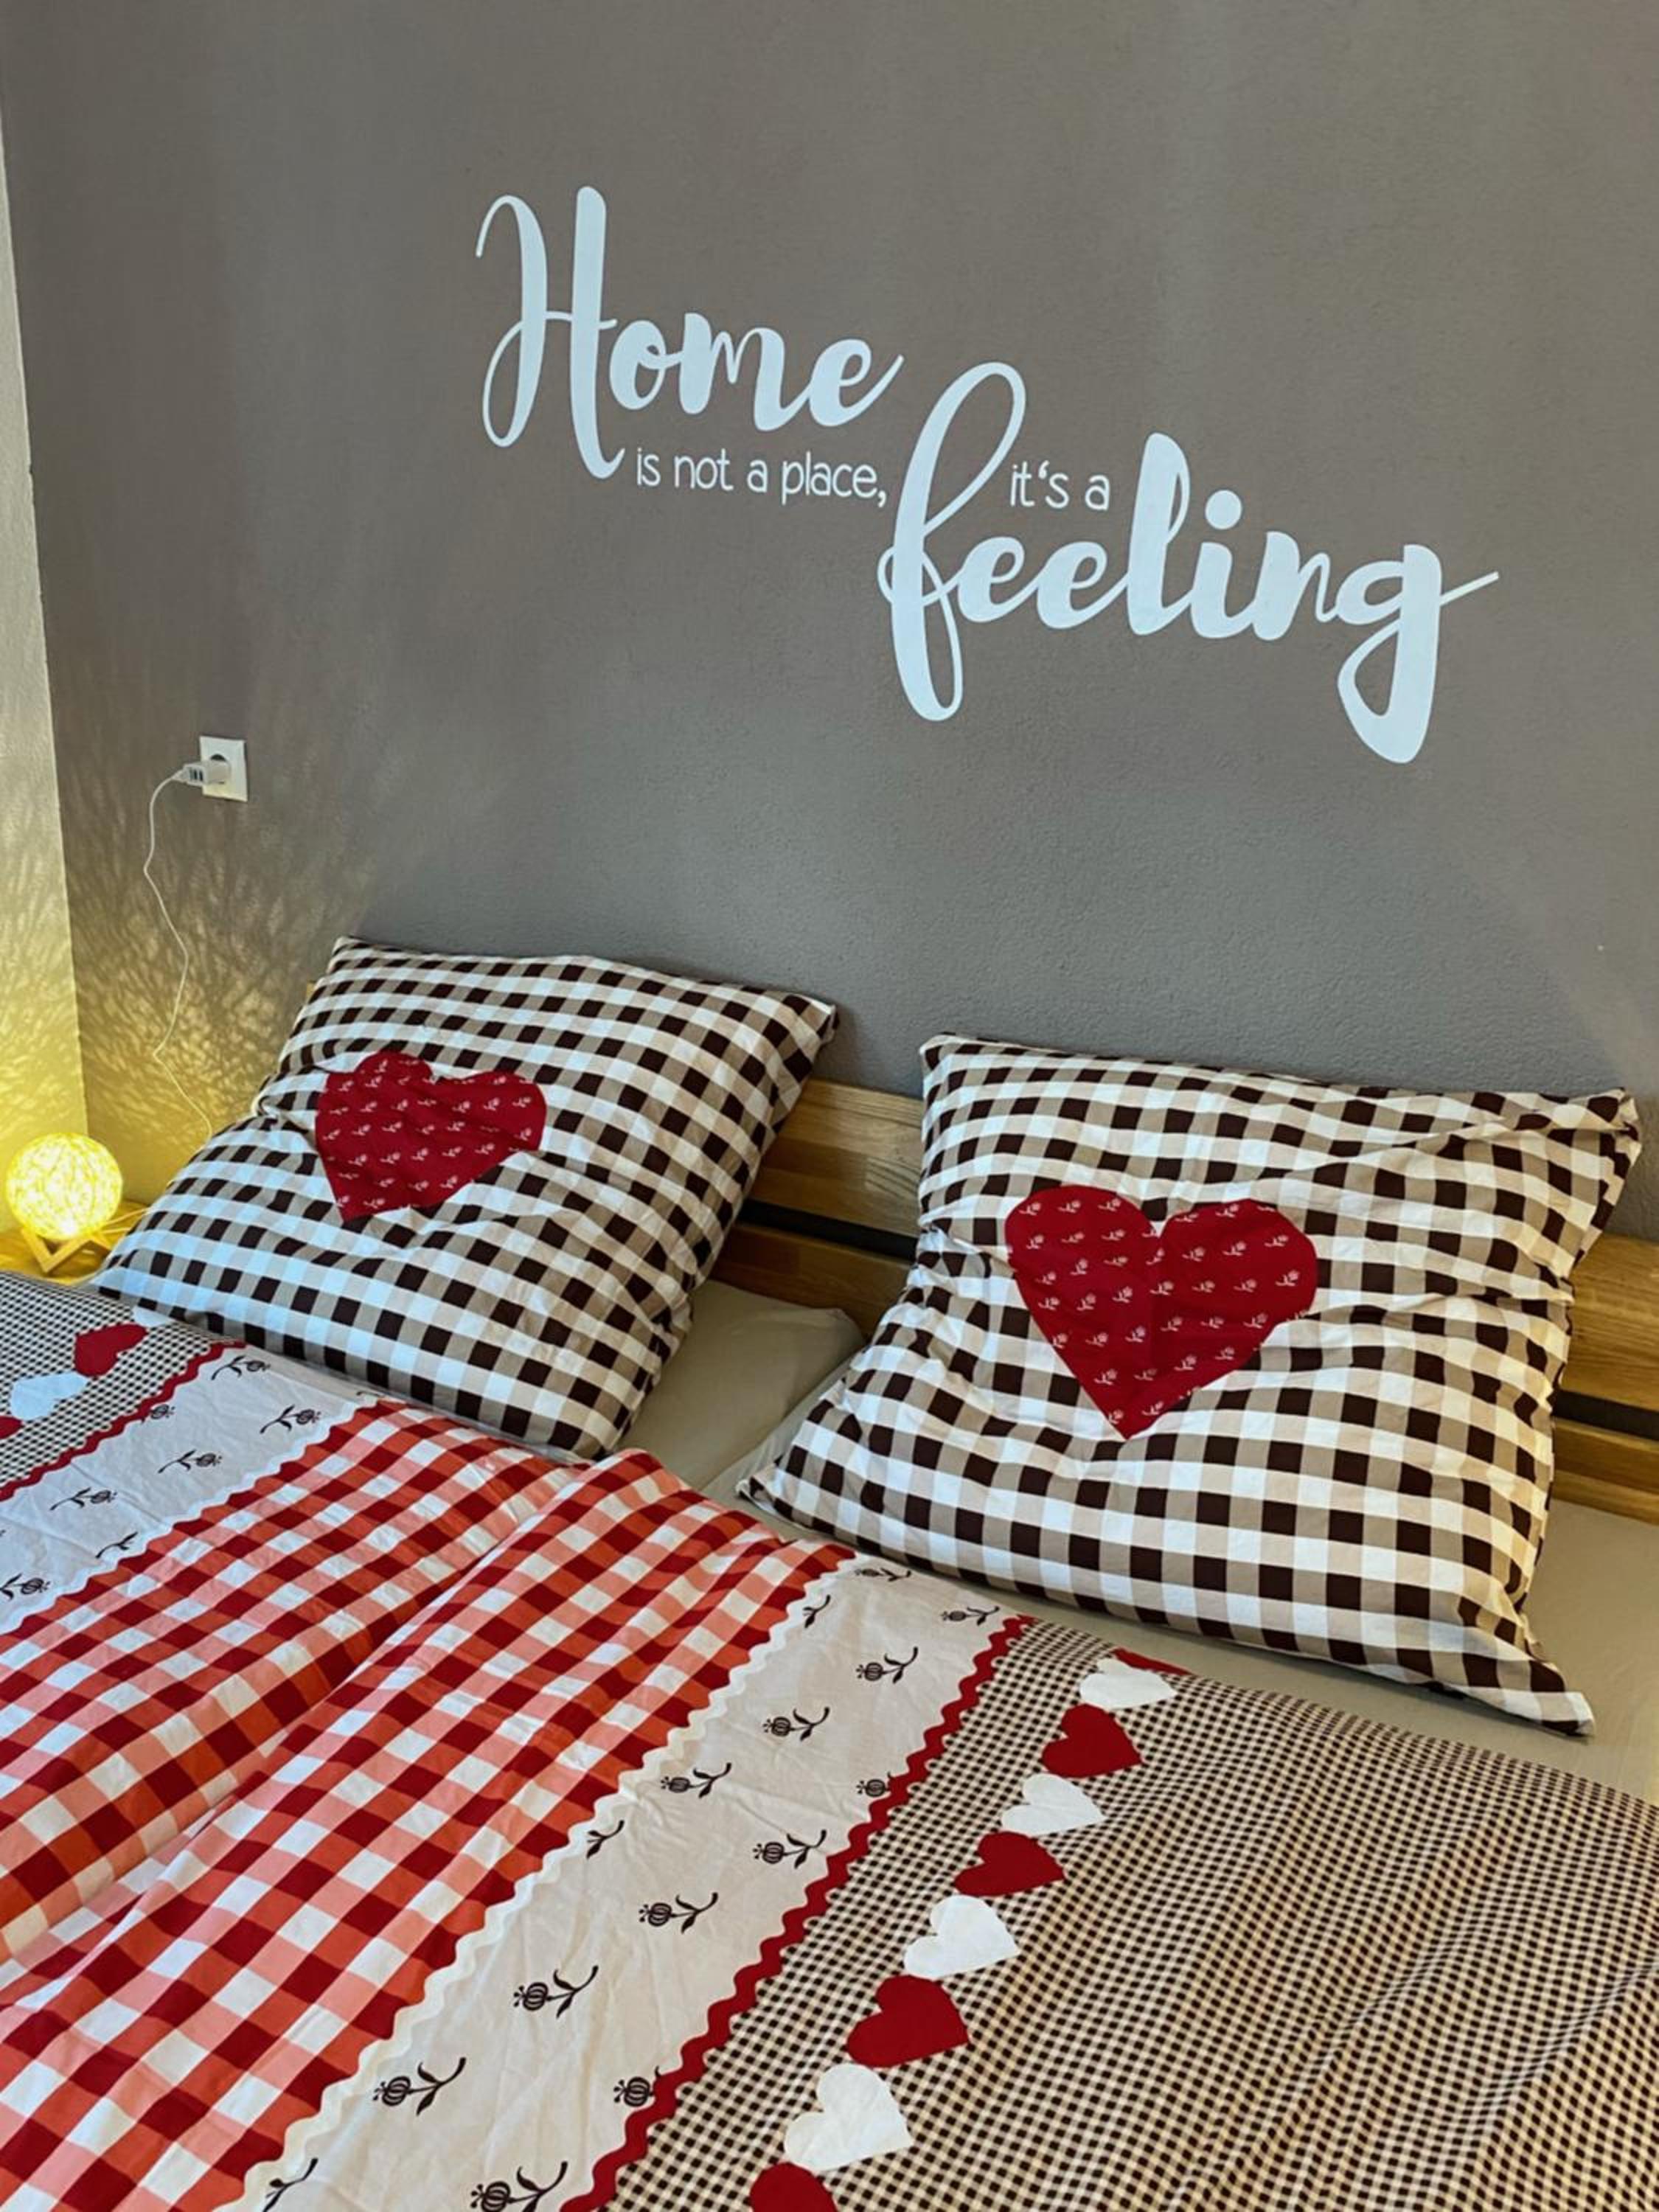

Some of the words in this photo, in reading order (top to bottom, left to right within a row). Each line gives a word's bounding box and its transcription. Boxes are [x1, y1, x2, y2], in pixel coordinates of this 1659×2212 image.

[476, 186, 904, 479] Home
[636, 447, 661, 487] is
[674, 448, 734, 491] not
[747, 459, 768, 493] a
[782, 451, 887, 509] place,
[877, 362, 1500, 763] feeling
[1085, 474, 1110, 511] a
